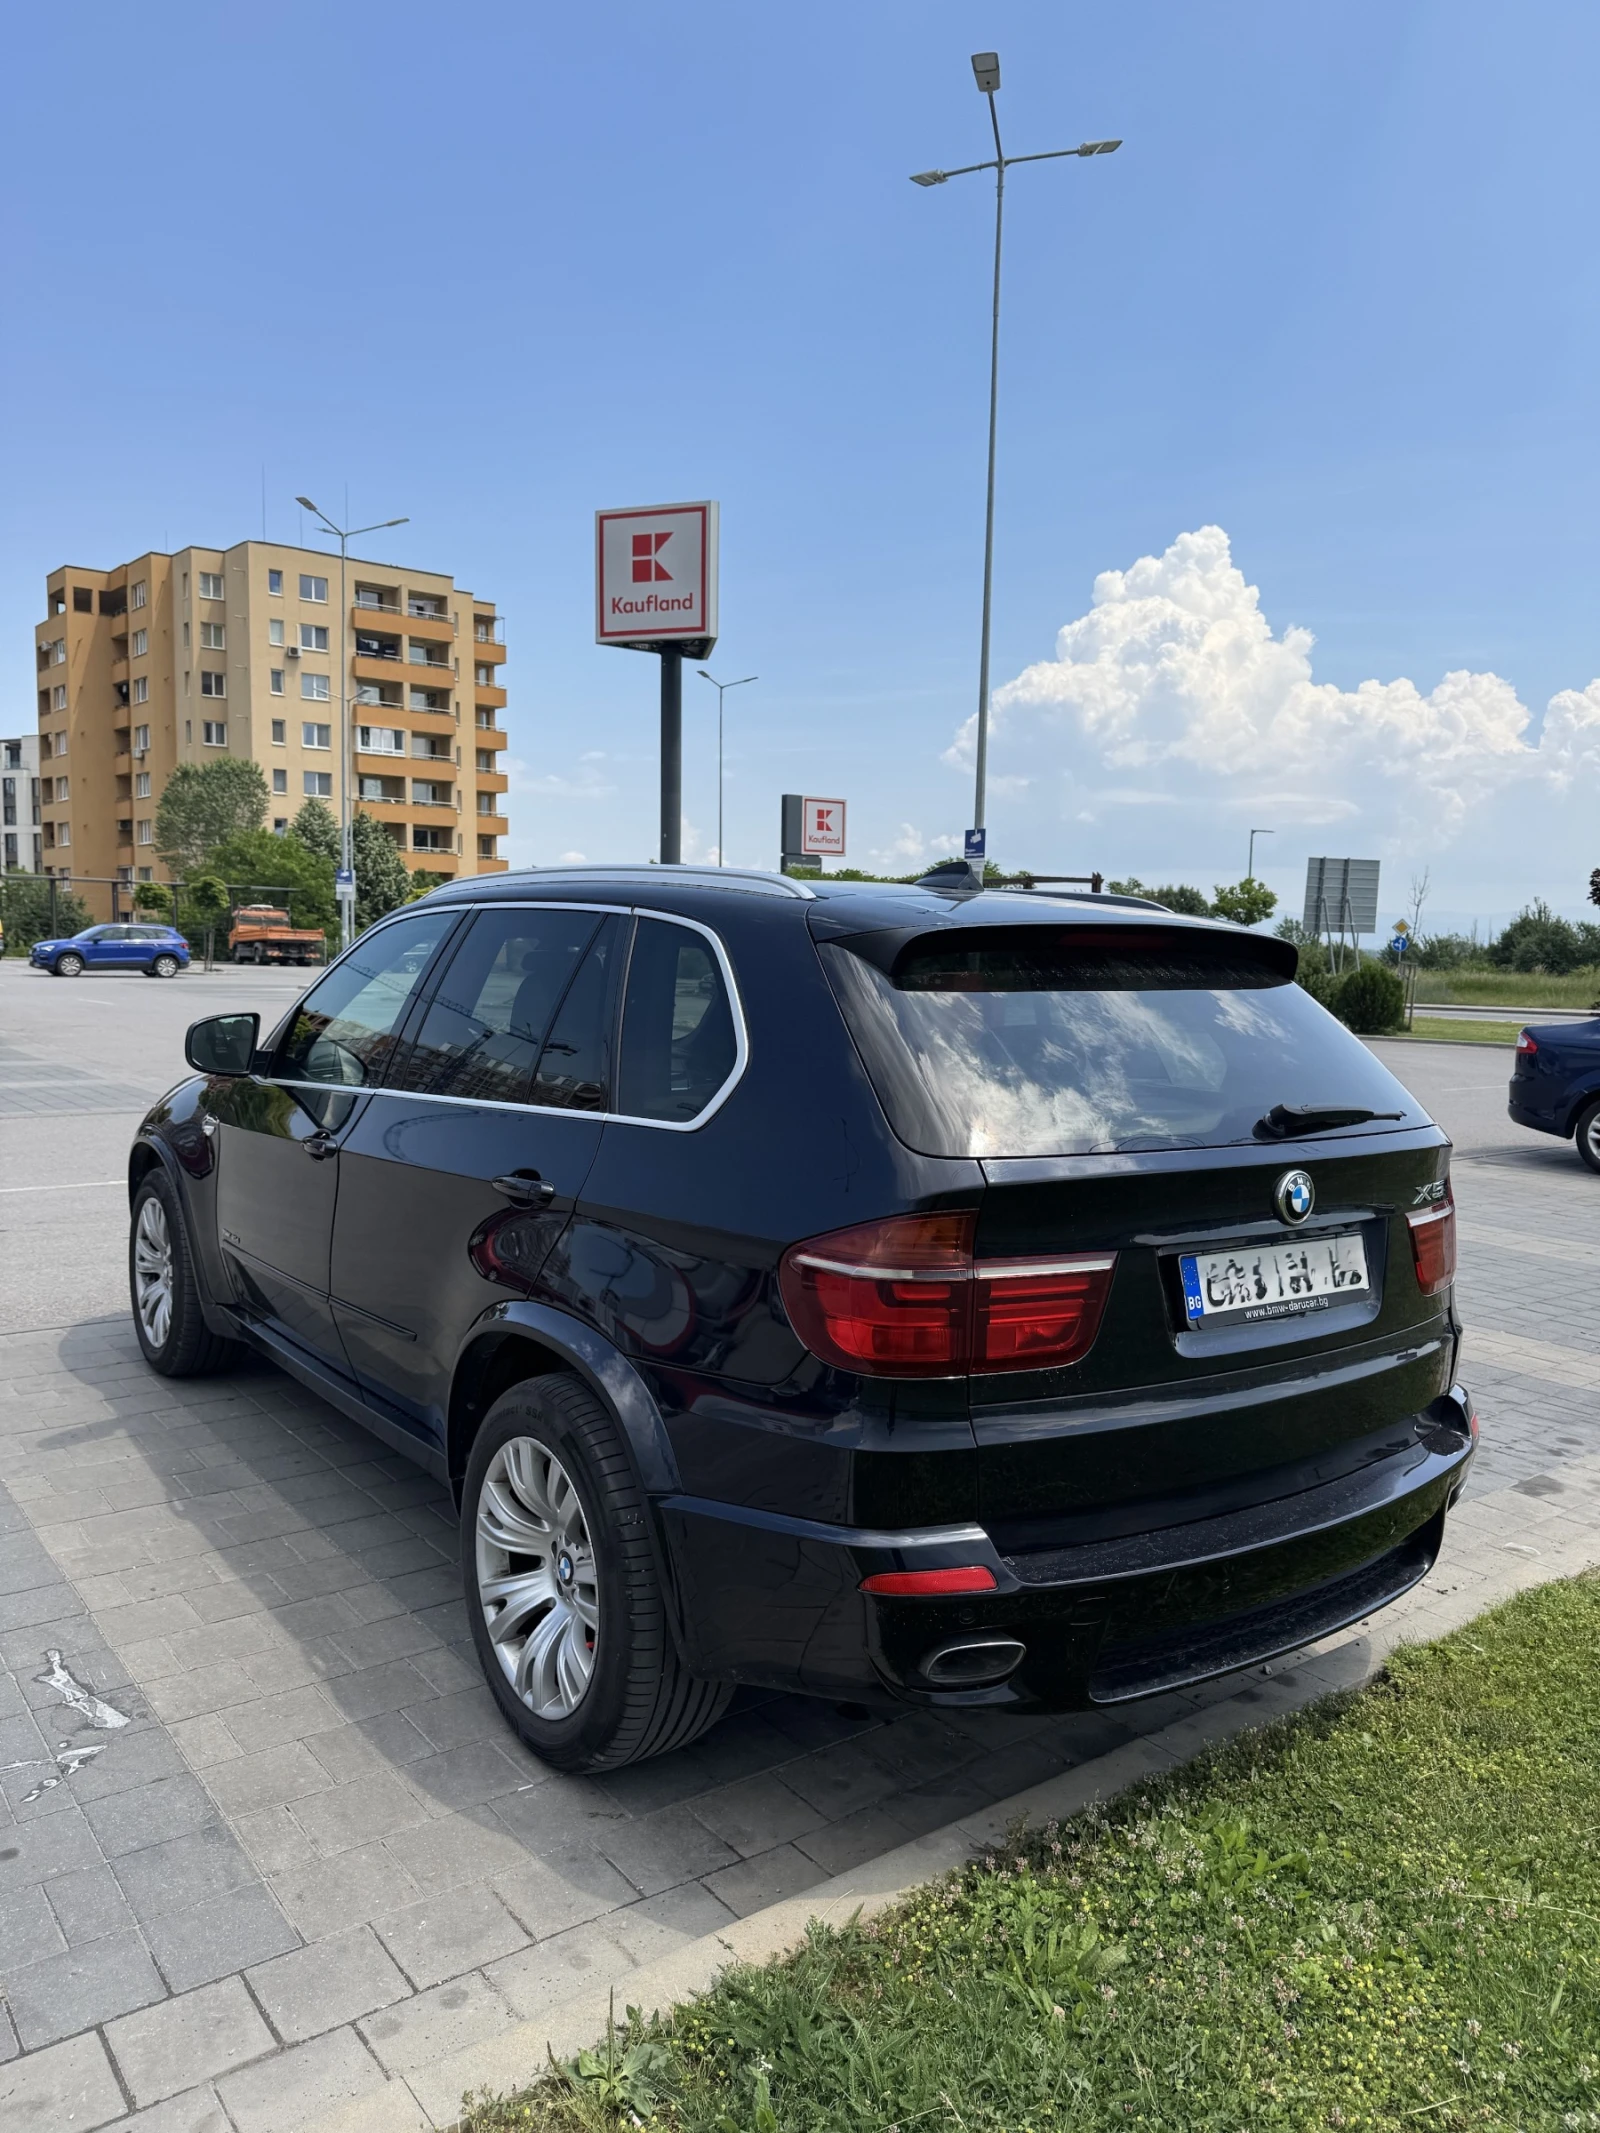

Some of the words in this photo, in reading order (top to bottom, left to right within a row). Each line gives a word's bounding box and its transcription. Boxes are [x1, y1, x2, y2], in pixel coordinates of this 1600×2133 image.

[612, 592, 693, 615] Kaufland
[808, 835, 840, 844] Kaufland
[1411, 1179, 1445, 1205] X5
[1187, 1295, 1202, 1311] BG
[1244, 1296, 1329, 1319] www.bmw-darucar.bg
